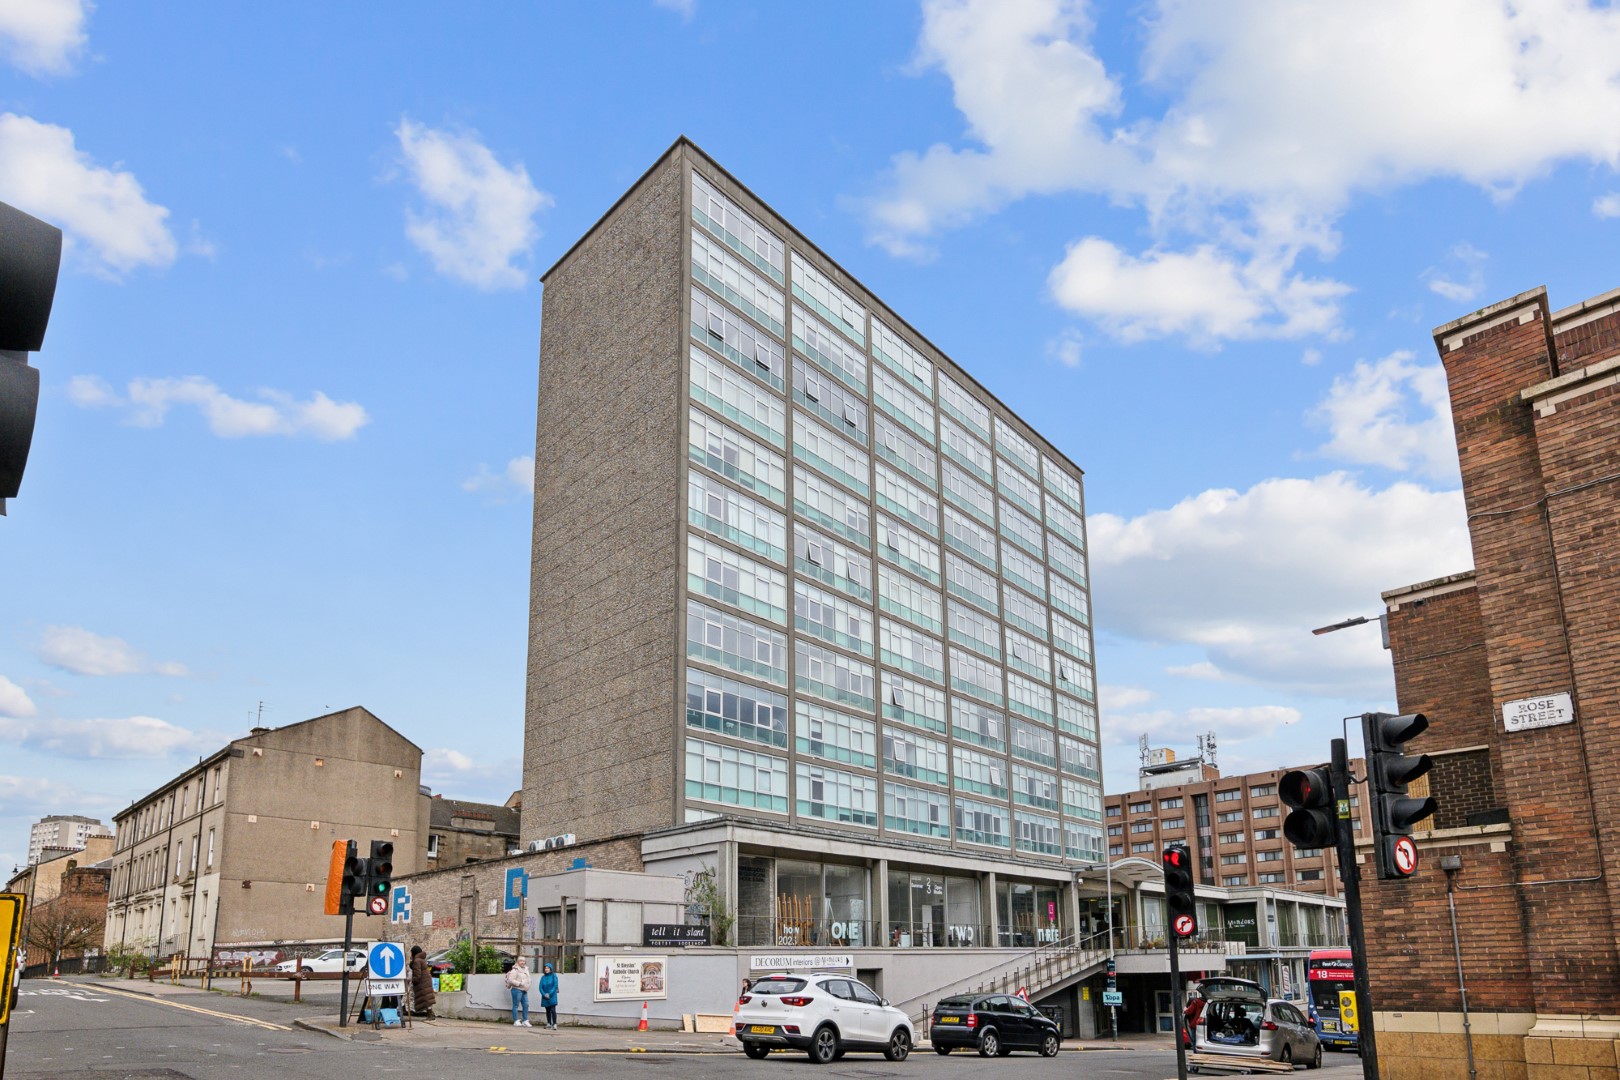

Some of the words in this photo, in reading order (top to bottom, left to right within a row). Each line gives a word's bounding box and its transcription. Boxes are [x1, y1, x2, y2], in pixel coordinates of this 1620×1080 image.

[1518, 700, 1555, 713] ROSE
[1511, 708, 1564, 724] STREET
[651, 926, 666, 936] tell
[673, 927, 680, 936] it
[686, 927, 703, 937] slant
[831, 921, 860, 939] ONE
[949, 925, 974, 941] TWO
[755, 957, 792, 967] DECORUM
[793, 958, 813, 966] interiors
[1317, 970, 1328, 979] 18
